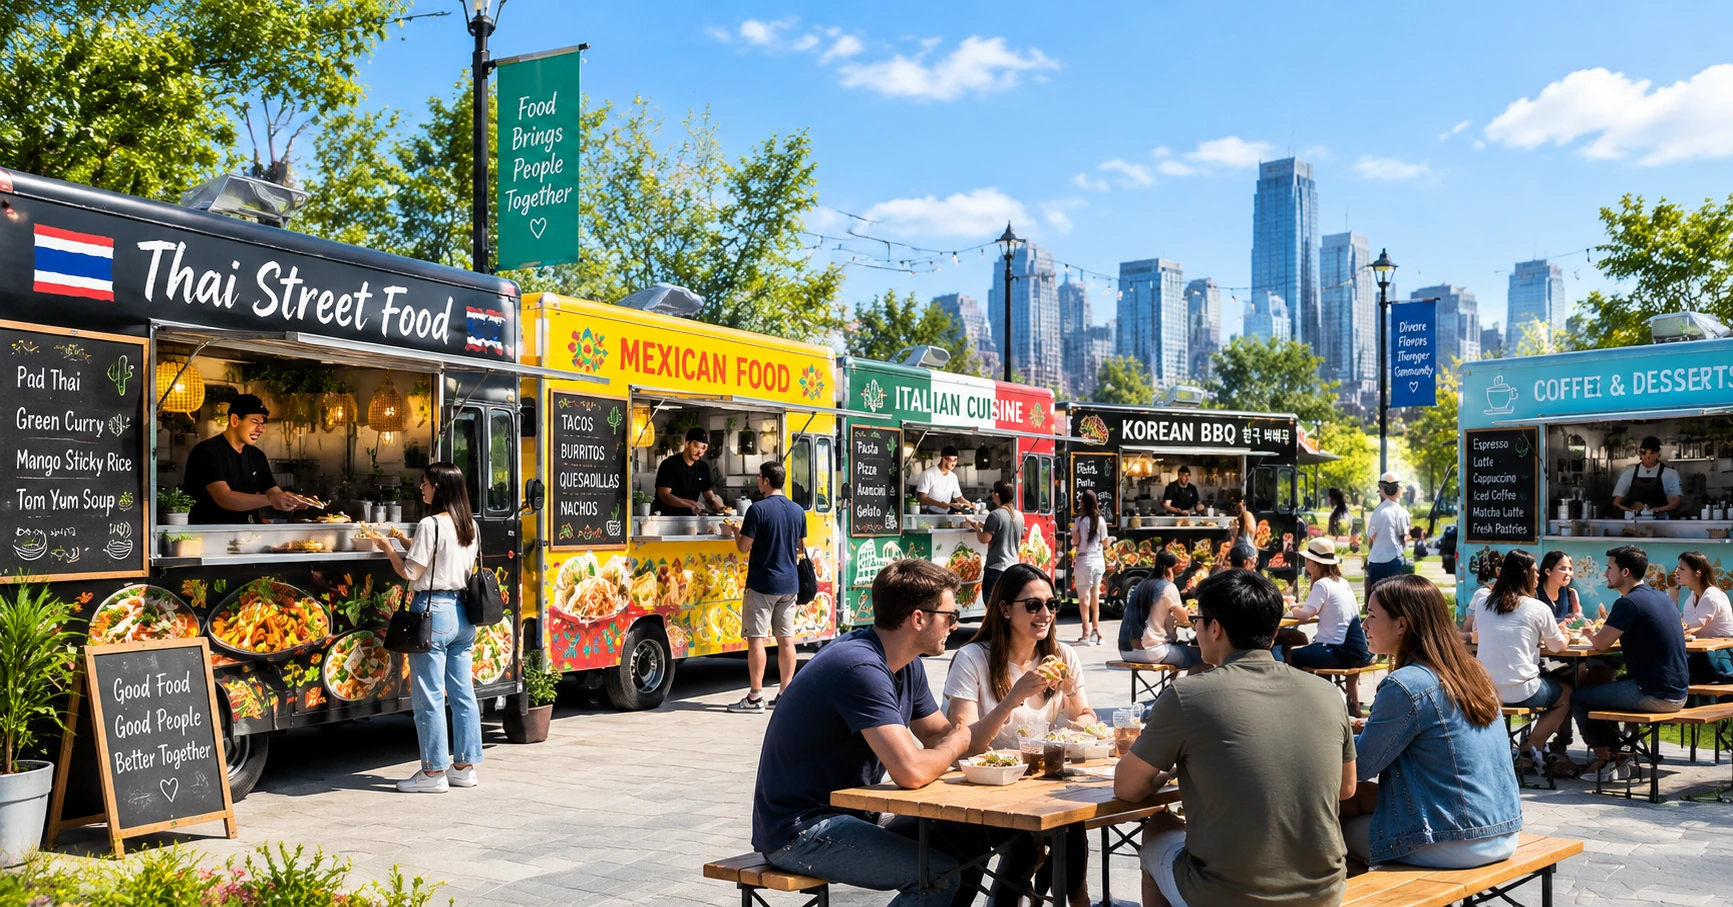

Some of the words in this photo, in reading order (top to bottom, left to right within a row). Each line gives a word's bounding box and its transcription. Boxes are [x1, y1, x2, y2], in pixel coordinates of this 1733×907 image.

[518, 91, 558, 120] Food
[512, 126, 563, 153] Brings
[513, 153, 563, 183] People
[505, 183, 573, 216] Together
[137, 240, 240, 309] Thai
[252, 260, 373, 331] Street
[381, 285, 454, 345] Food
[17, 365, 45, 390] Pad
[50, 368, 81, 392] Thai
[620, 337, 727, 385] MEXICAN
[736, 357, 790, 393] FOOD
[1610, 374, 1626, 396] &
[895, 385, 960, 417] ITALIAN
[967, 396, 1024, 424] CUISINE
[16, 407, 60, 431] Green
[65, 410, 104, 438] Curry
[561, 414, 594, 432] TACOS
[1122, 419, 1194, 442] KOREAN
[1201, 423, 1236, 445] BBQ
[561, 443, 605, 461] BURRITOS
[1473, 438, 1509, 452] Espresso
[16, 449, 61, 476] Mango
[65, 449, 104, 477] Sticky
[107, 452, 132, 472] Rice
[559, 471, 620, 489] QUESADILLAS
[1473, 472, 1517, 486] Cappuccino
[16, 488, 45, 511] Tom
[50, 488, 79, 511] Yum
[83, 488, 115, 517] Soup
[560, 501, 598, 516] NACHOS
[1473, 490, 1489, 501] Iced
[1491, 489, 1517, 502] Coffee
[1503, 506, 1524, 517] Latte
[113, 674, 151, 705] Good
[156, 671, 191, 697] Food
[115, 710, 152, 739] Good
[155, 706, 202, 736] People
[114, 749, 155, 775] Better
[157, 740, 211, 770] Together
